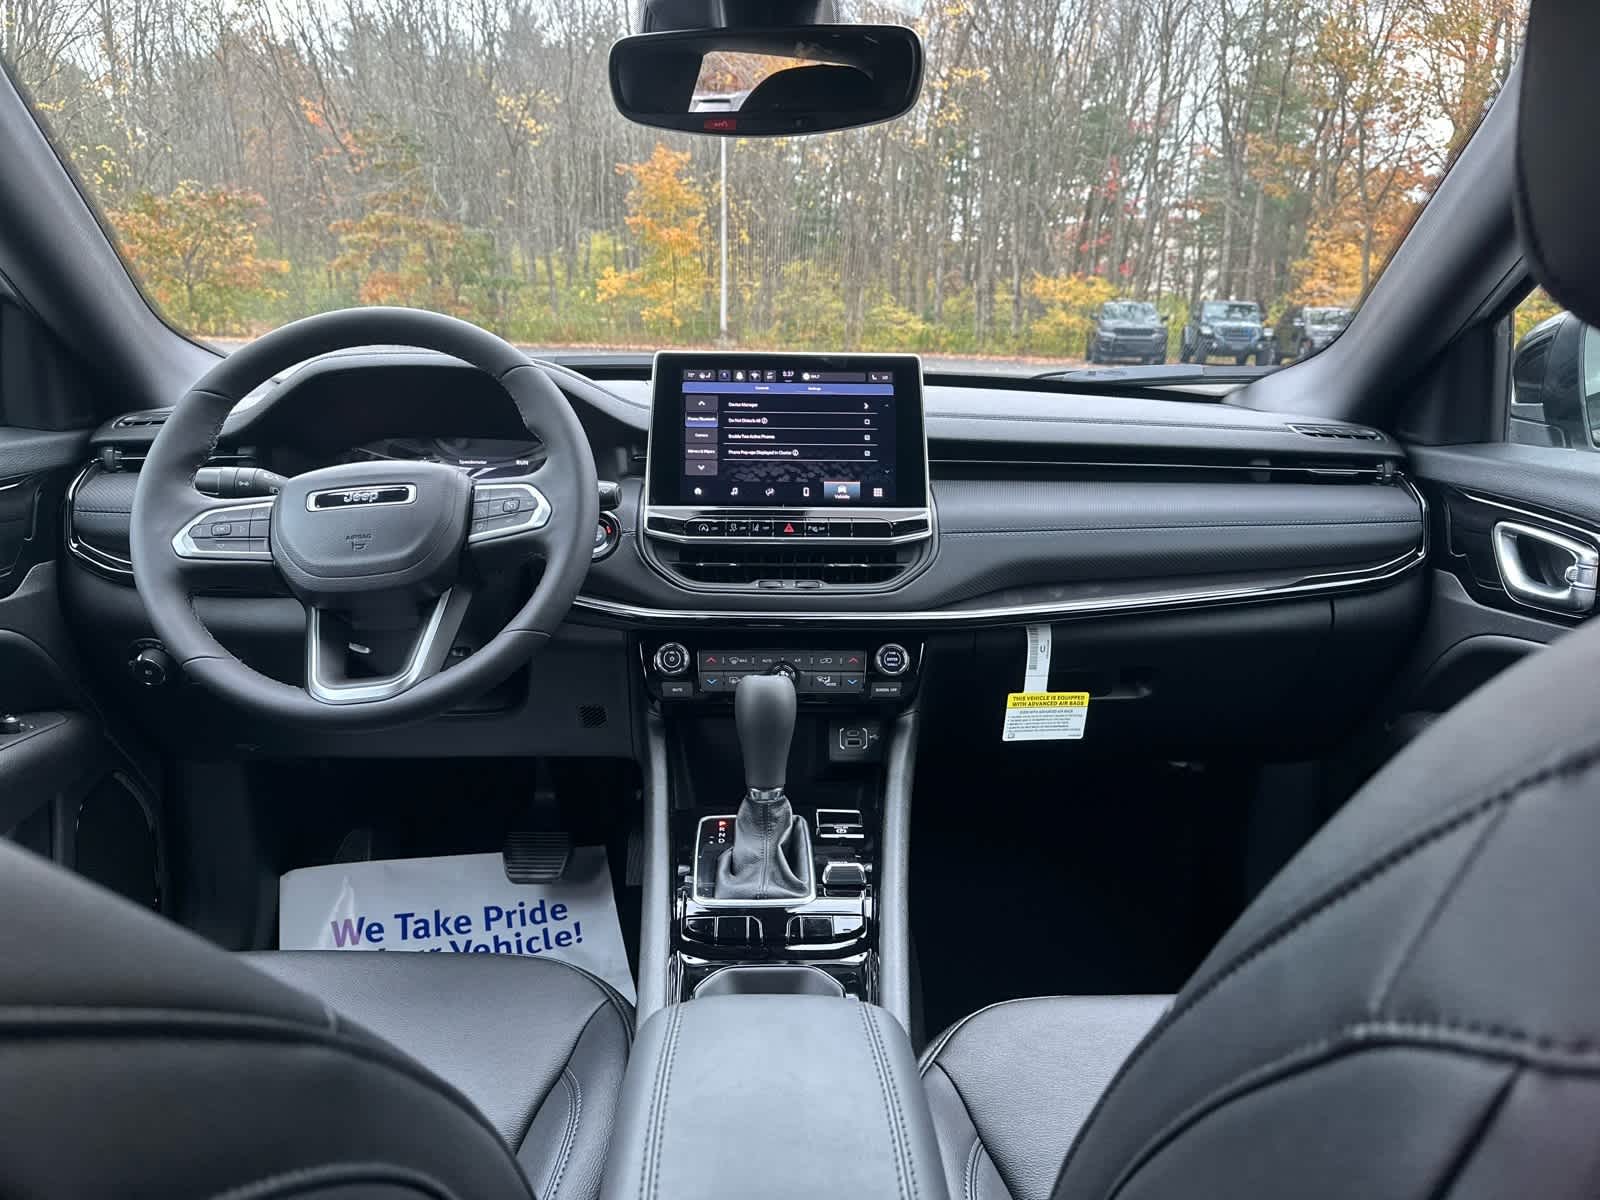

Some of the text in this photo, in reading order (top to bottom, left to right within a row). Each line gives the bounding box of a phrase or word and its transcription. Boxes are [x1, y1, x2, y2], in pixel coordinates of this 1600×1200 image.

[343, 491, 379, 503] Jeep
[331, 899, 568, 948] We Take Pride
